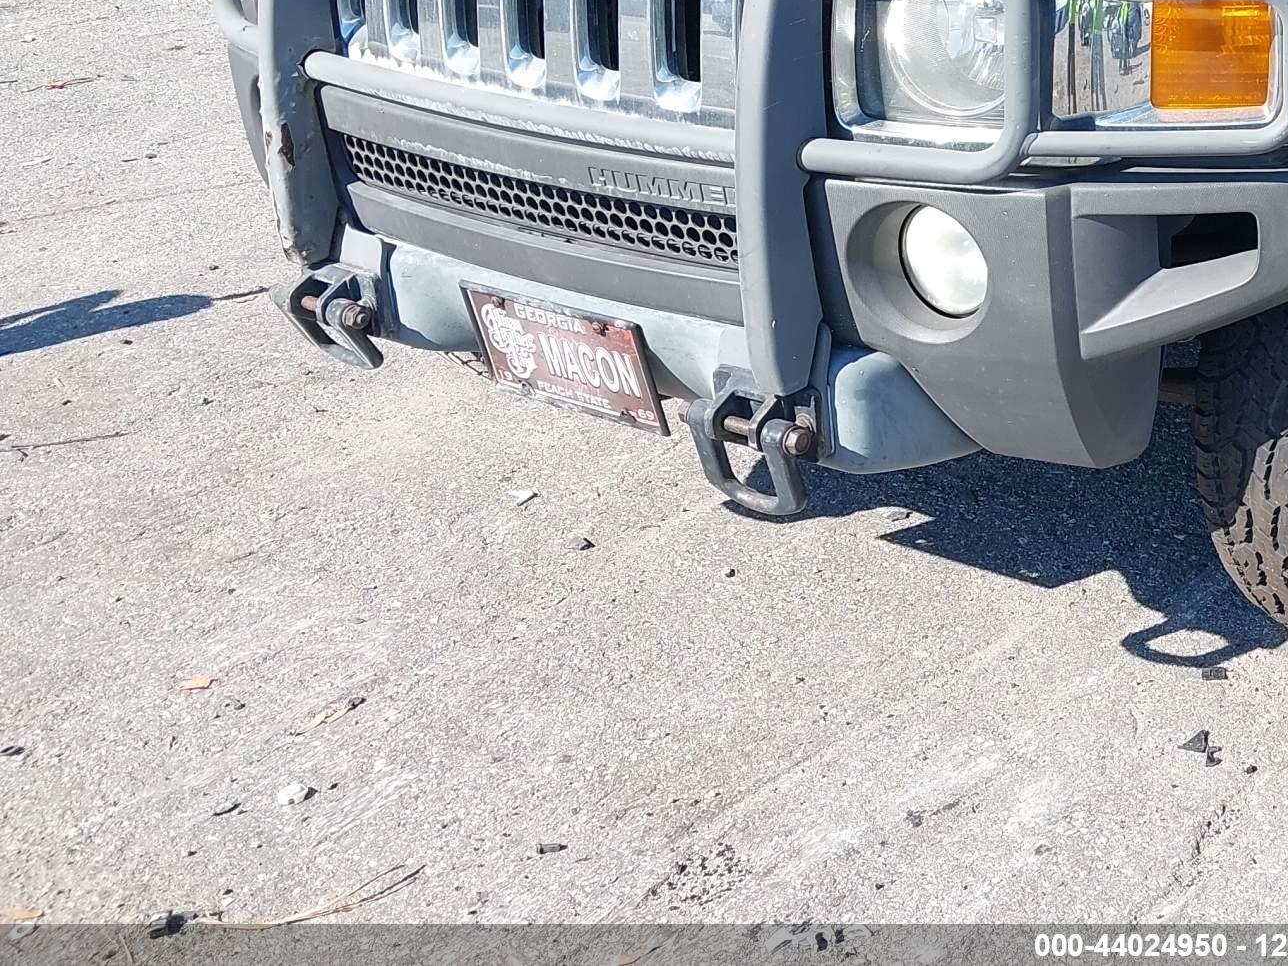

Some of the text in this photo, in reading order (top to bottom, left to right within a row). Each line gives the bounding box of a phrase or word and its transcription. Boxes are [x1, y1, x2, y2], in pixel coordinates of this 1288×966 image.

[514, 303, 586, 335] GEORGIA
[536, 332, 641, 399] MACON
[536, 379, 575, 398] PEACH
[638, 407, 656, 421] 69
